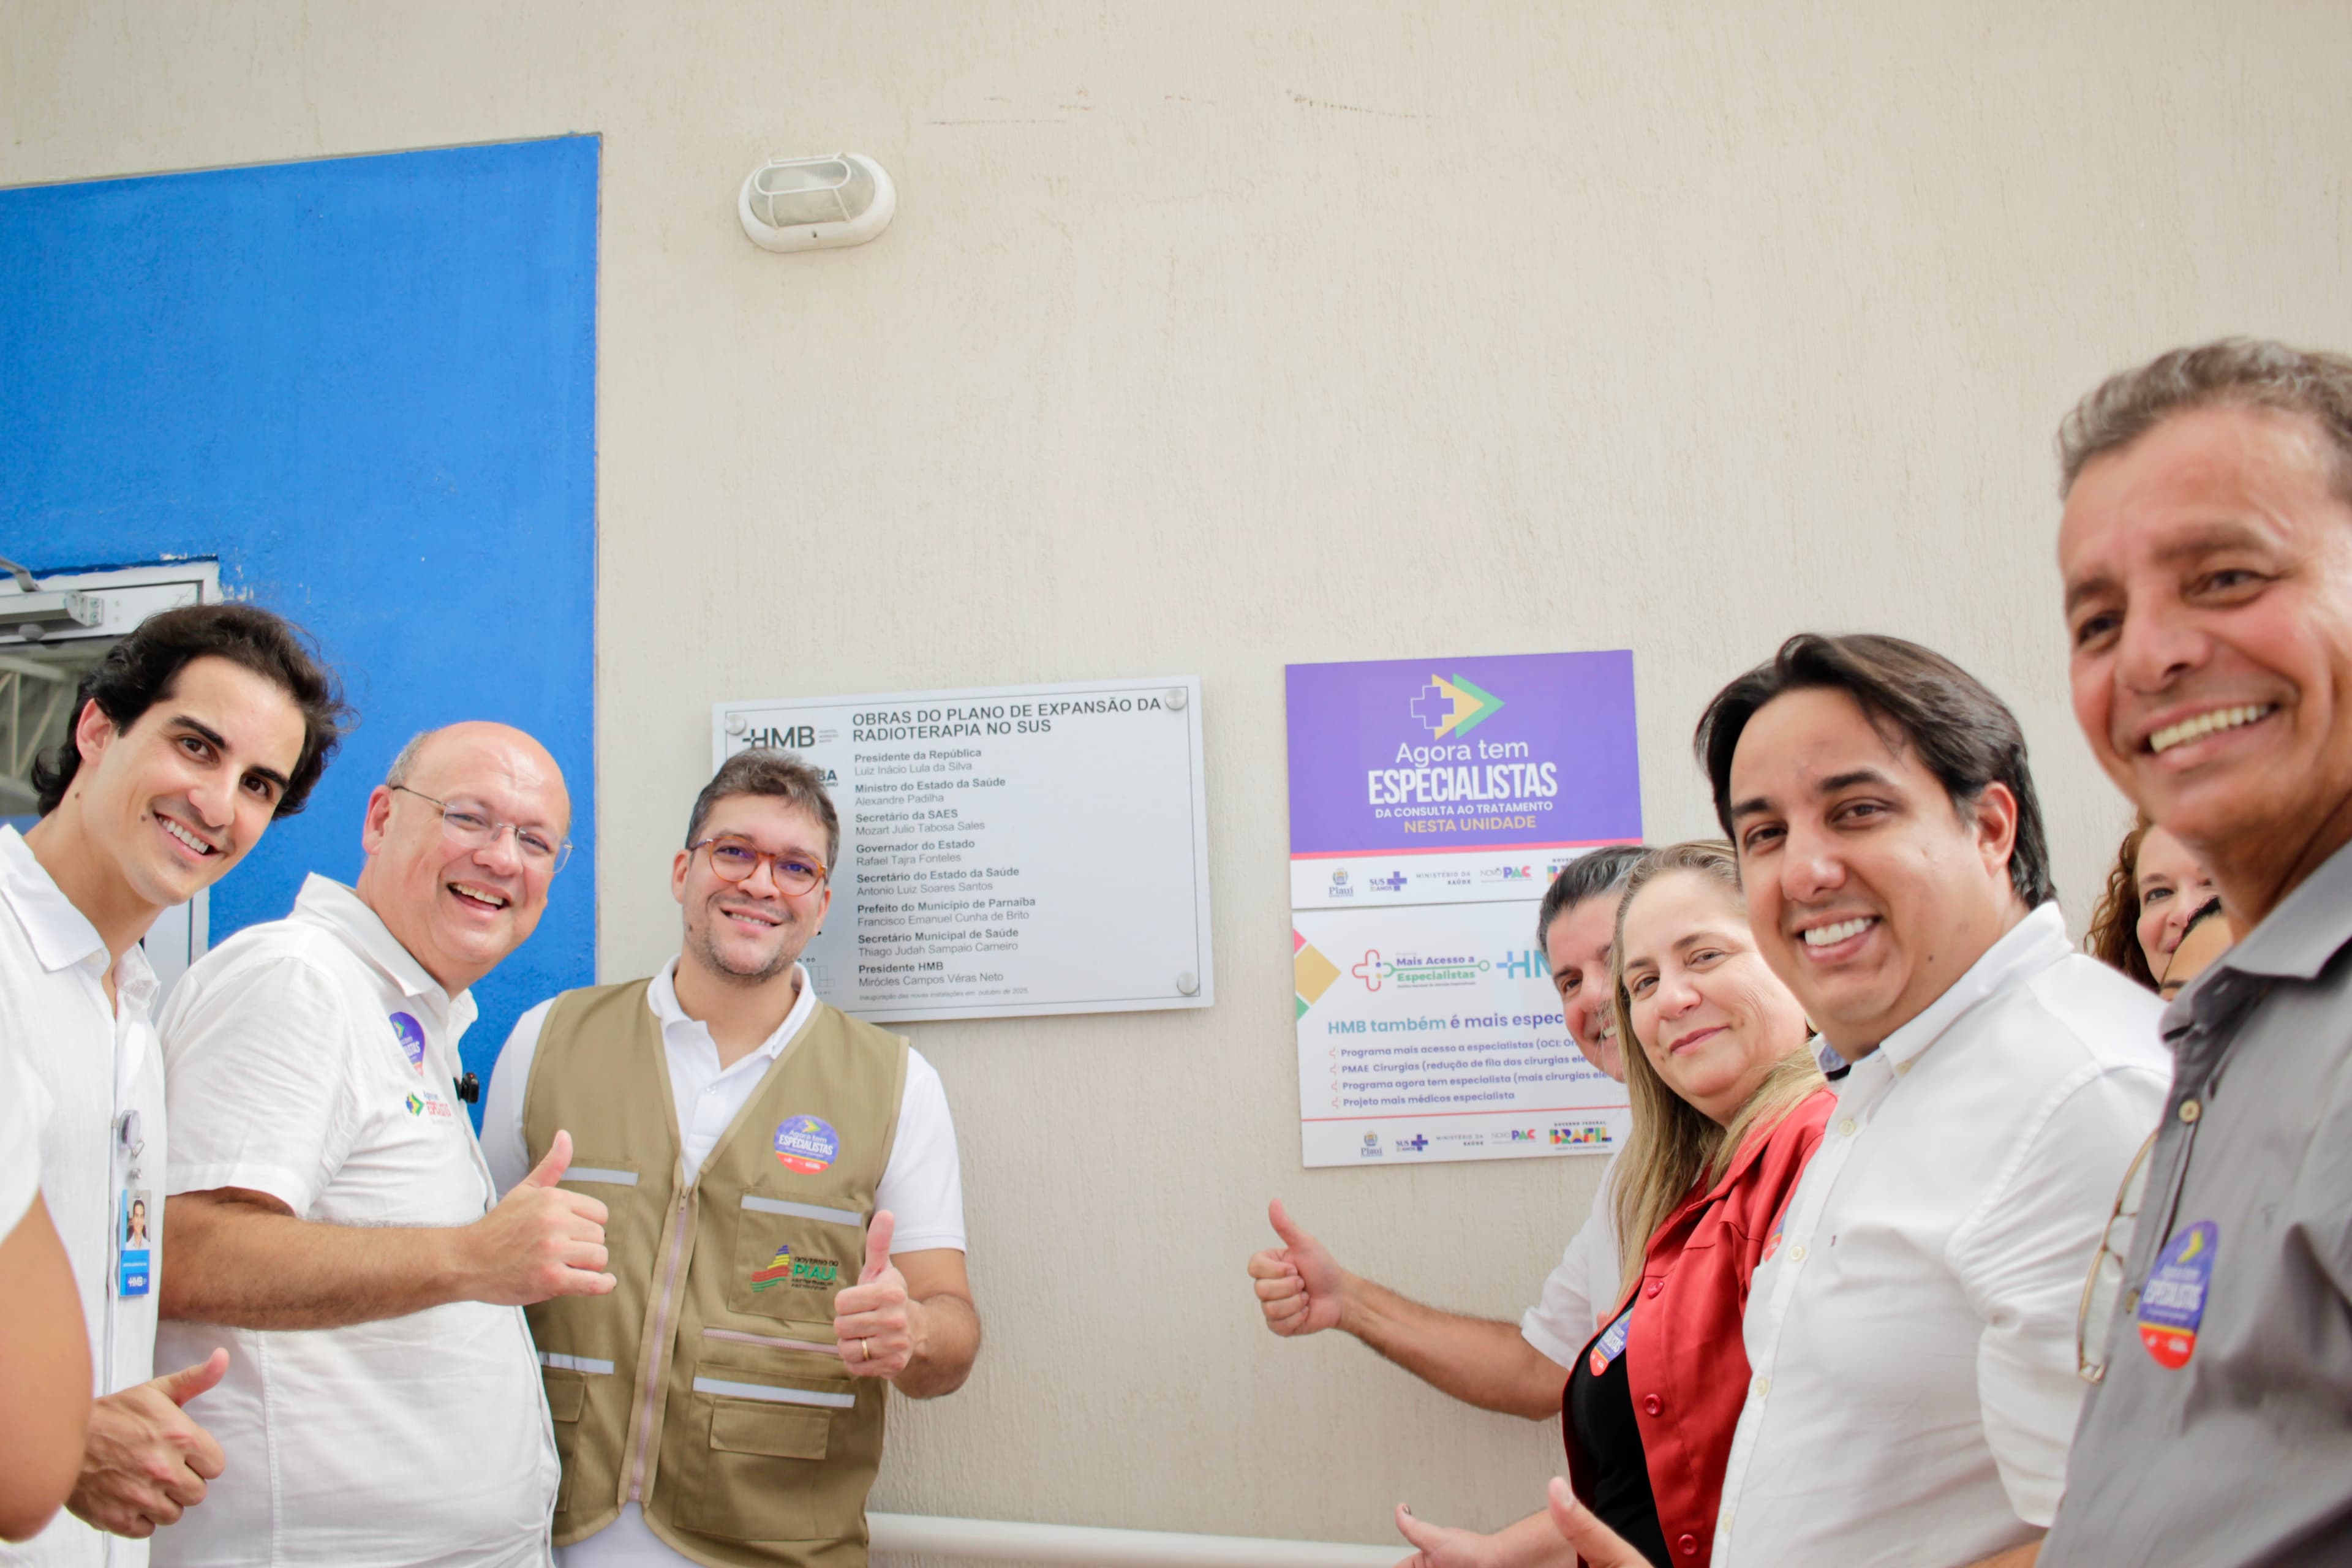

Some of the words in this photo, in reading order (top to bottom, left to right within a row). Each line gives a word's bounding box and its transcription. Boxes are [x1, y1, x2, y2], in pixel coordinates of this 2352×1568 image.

[853, 710, 911, 726] OBRAS
[918, 709, 941, 723] DO
[948, 706, 1005, 720] PLANO
[1011, 704, 1033, 717] DE
[1039, 697, 1132, 716] EXPANSÃO
[1137, 698, 1161, 710] DA
[853, 723, 982, 742] RADIOTERAPIA
[987, 722, 1011, 734] NO
[1017, 719, 1052, 733] SUS
[854, 752, 910, 763] Presidente
[913, 751, 926, 760] da
[929, 748, 982, 760] República
[1395, 742, 1471, 767] Agora
[1478, 739, 1529, 760] tem
[854, 767, 875, 776] Luiz
[878, 764, 907, 775] Inácio
[910, 763, 930, 774] Lula
[933, 763, 945, 772] da
[948, 761, 973, 771] Silva
[855, 782, 897, 794] Ministro
[900, 782, 914, 791] do
[917, 780, 954, 790] Estado
[957, 778, 970, 788] da
[973, 777, 1006, 787] Saúde
[1368, 762, 1558, 805] ESPECIALISTAS
[855, 796, 905, 806] Alexandre
[908, 793, 944, 804] Padilha
[856, 812, 909, 823] Secretário
[912, 811, 925, 820] da
[928, 809, 959, 819] SAES
[1375, 809, 1392, 818] DA
[1394, 805, 1455, 818] CONSULTA
[1457, 804, 1474, 815] AO
[1477, 801, 1553, 814] TRATAMENTO
[856, 827, 890, 835] Mozart
[918, 823, 954, 833] Tabosa
[957, 821, 985, 831] Sales
[1404, 820, 1457, 834] NESTA
[1460, 815, 1536, 831] UNIDADE
[856, 842, 918, 853] Governador
[922, 841, 935, 850] do
[938, 839, 976, 850] Estado
[856, 856, 888, 866] Rafael
[891, 855, 916, 865] Tajra
[919, 853, 961, 864] Fonteles
[857, 872, 911, 883] Secretário
[913, 871, 927, 880] do
[930, 870, 967, 880] Estado
[970, 869, 983, 878] da
[986, 867, 1019, 877] Saúde
[1503, 865, 1531, 878] PAC
[857, 886, 895, 897] Antonio
[897, 884, 918, 894] Luiz
[920, 883, 956, 894] Soares
[958, 882, 993, 892] Santos
[858, 903, 899, 914] Prefeito
[901, 903, 914, 912] do
[918, 900, 970, 913] Município
[973, 899, 986, 908] de
[989, 897, 1036, 908] Parnaíba
[858, 916, 906, 927] Francisco
[908, 914, 952, 925] Emanuel
[955, 913, 989, 923] Cunha
[990, 911, 1004, 921] de
[1006, 910, 1030, 921] Brito
[858, 933, 912, 944] Secretário
[915, 930, 966, 942] Municipal
[969, 929, 982, 938] de
[985, 927, 1019, 938] Saúde
[859, 948, 892, 959] Thiago
[894, 945, 925, 956] Judah
[928, 942, 973, 954] Sampaio
[859, 964, 915, 974] Presidente
[919, 962, 944, 971] HMB
[1396, 957, 1422, 966] Mais
[1426, 956, 1465, 965] Acesso
[859, 976, 900, 987] Mirócles
[903, 974, 945, 986] Campos
[948, 972, 977, 983] Véras
[980, 972, 1004, 982] Neto
[1397, 970, 1476, 984] Especialistas
[1328, 1020, 1366, 1035] HMB
[1371, 1016, 1446, 1032] também
[1450, 1015, 1460, 1028] é
[1464, 1013, 1508, 1028] mais
[1512, 1014, 1564, 1029] espec
[1341, 1047, 1392, 1058] Programa
[1393, 1045, 1419, 1055] mais
[1421, 1044, 1456, 1054] acesso
[1467, 1040, 1534, 1052] especialistas
[1342, 1064, 1370, 1073] PMAE
[1373, 1061, 1420, 1073] Cirurgias
[1422, 1060, 1468, 1072] (redução
[1471, 1060, 1483, 1068] de
[1485, 1058, 1501, 1067] fila
[1504, 1057, 1522, 1066] das
[1525, 1055, 1569, 1067] cirurgias
[1343, 1080, 1393, 1091] Programa
[1395, 1079, 1425, 1090] agora
[1427, 1078, 1447, 1087] tem
[1450, 1074, 1511, 1087] especialista
[1513, 1072, 1543, 1084] (mais
[1545, 1070, 1591, 1082] cirurgias
[1343, 1097, 1379, 1108] Projeto
[1381, 1095, 1406, 1104] mais
[1408, 1093, 1451, 1104] médicos
[1453, 1091, 1515, 1102] especialista
[1511, 1129, 1536, 1140] PAC
[1549, 1127, 1613, 1145] BRASIL
[778, 1134, 834, 1155] ESPECIALISTAS
